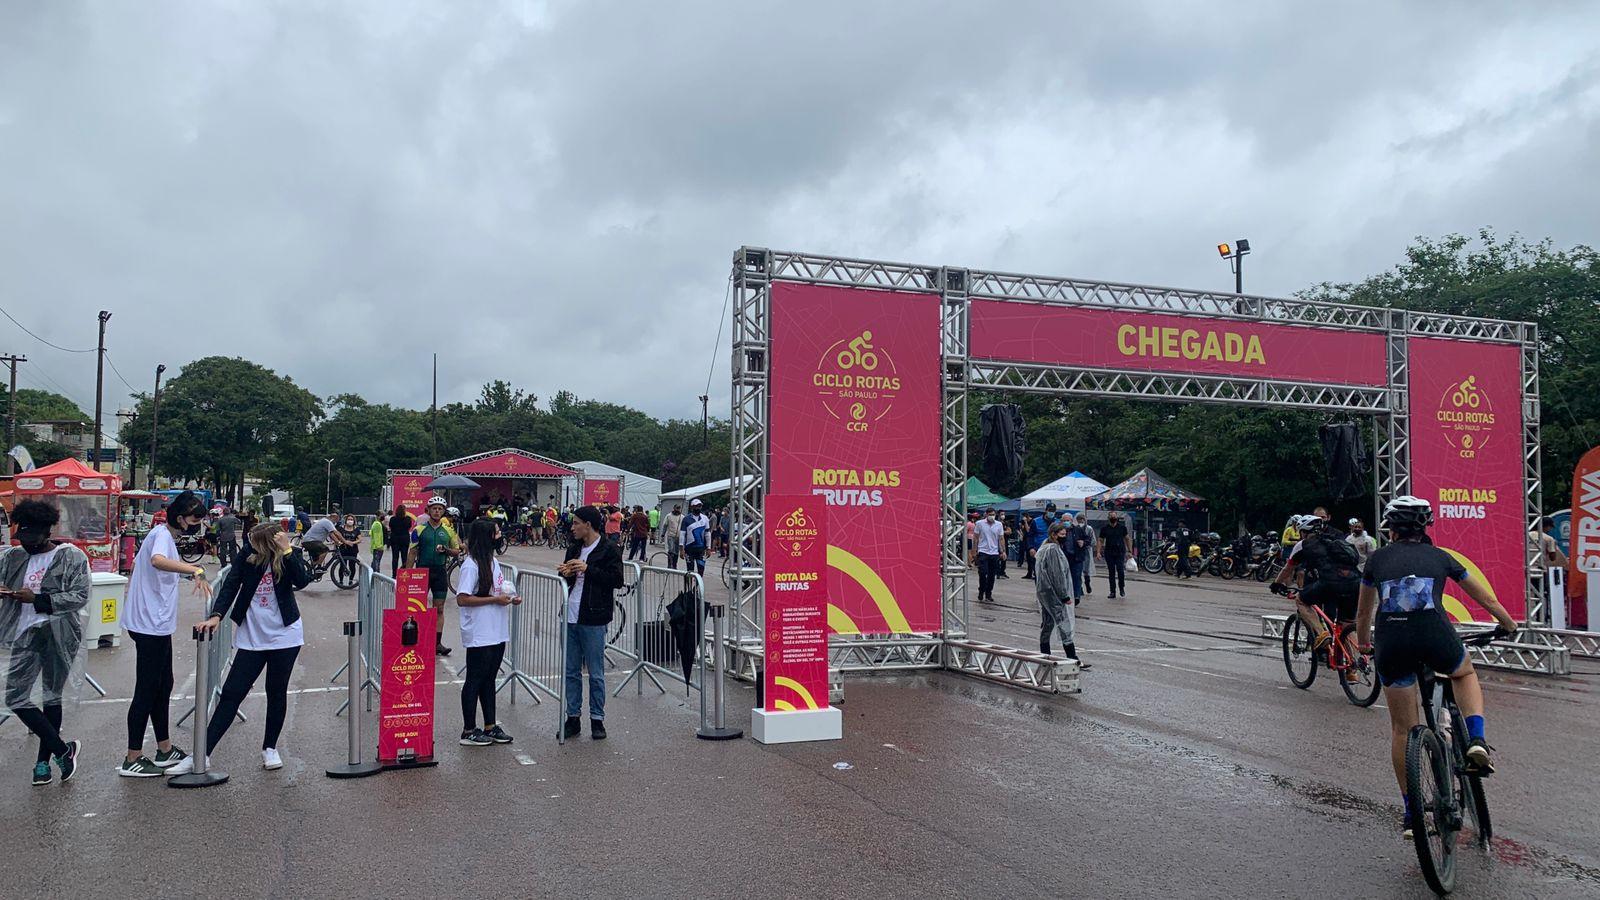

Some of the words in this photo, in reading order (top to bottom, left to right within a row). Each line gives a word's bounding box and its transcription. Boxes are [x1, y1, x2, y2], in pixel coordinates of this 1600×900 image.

[1117, 324, 1266, 365] CHEGADA
[813, 373, 853, 388] CICLO
[856, 375, 901, 390] ROTAS
[839, 389, 854, 398] SÃO
[854, 391, 878, 399] PAULO
[1437, 410, 1464, 422] CICLO
[1465, 411, 1495, 424] ROTAS
[846, 421, 868, 431] CCR
[1459, 449, 1475, 458] CCR
[812, 468, 860, 486] ROTA
[863, 470, 901, 487] DAS
[1439, 488, 1471, 502] ROTA
[1471, 489, 1497, 503] DAS
[1439, 504, 1486, 519] FRUTAS
[1576, 470, 1600, 573] STRAVA
[795, 528, 818, 536] ROTAS
[775, 573, 798, 581] ROTA
[799, 572, 818, 581] DAS
[775, 582, 810, 591] FRUTAS
